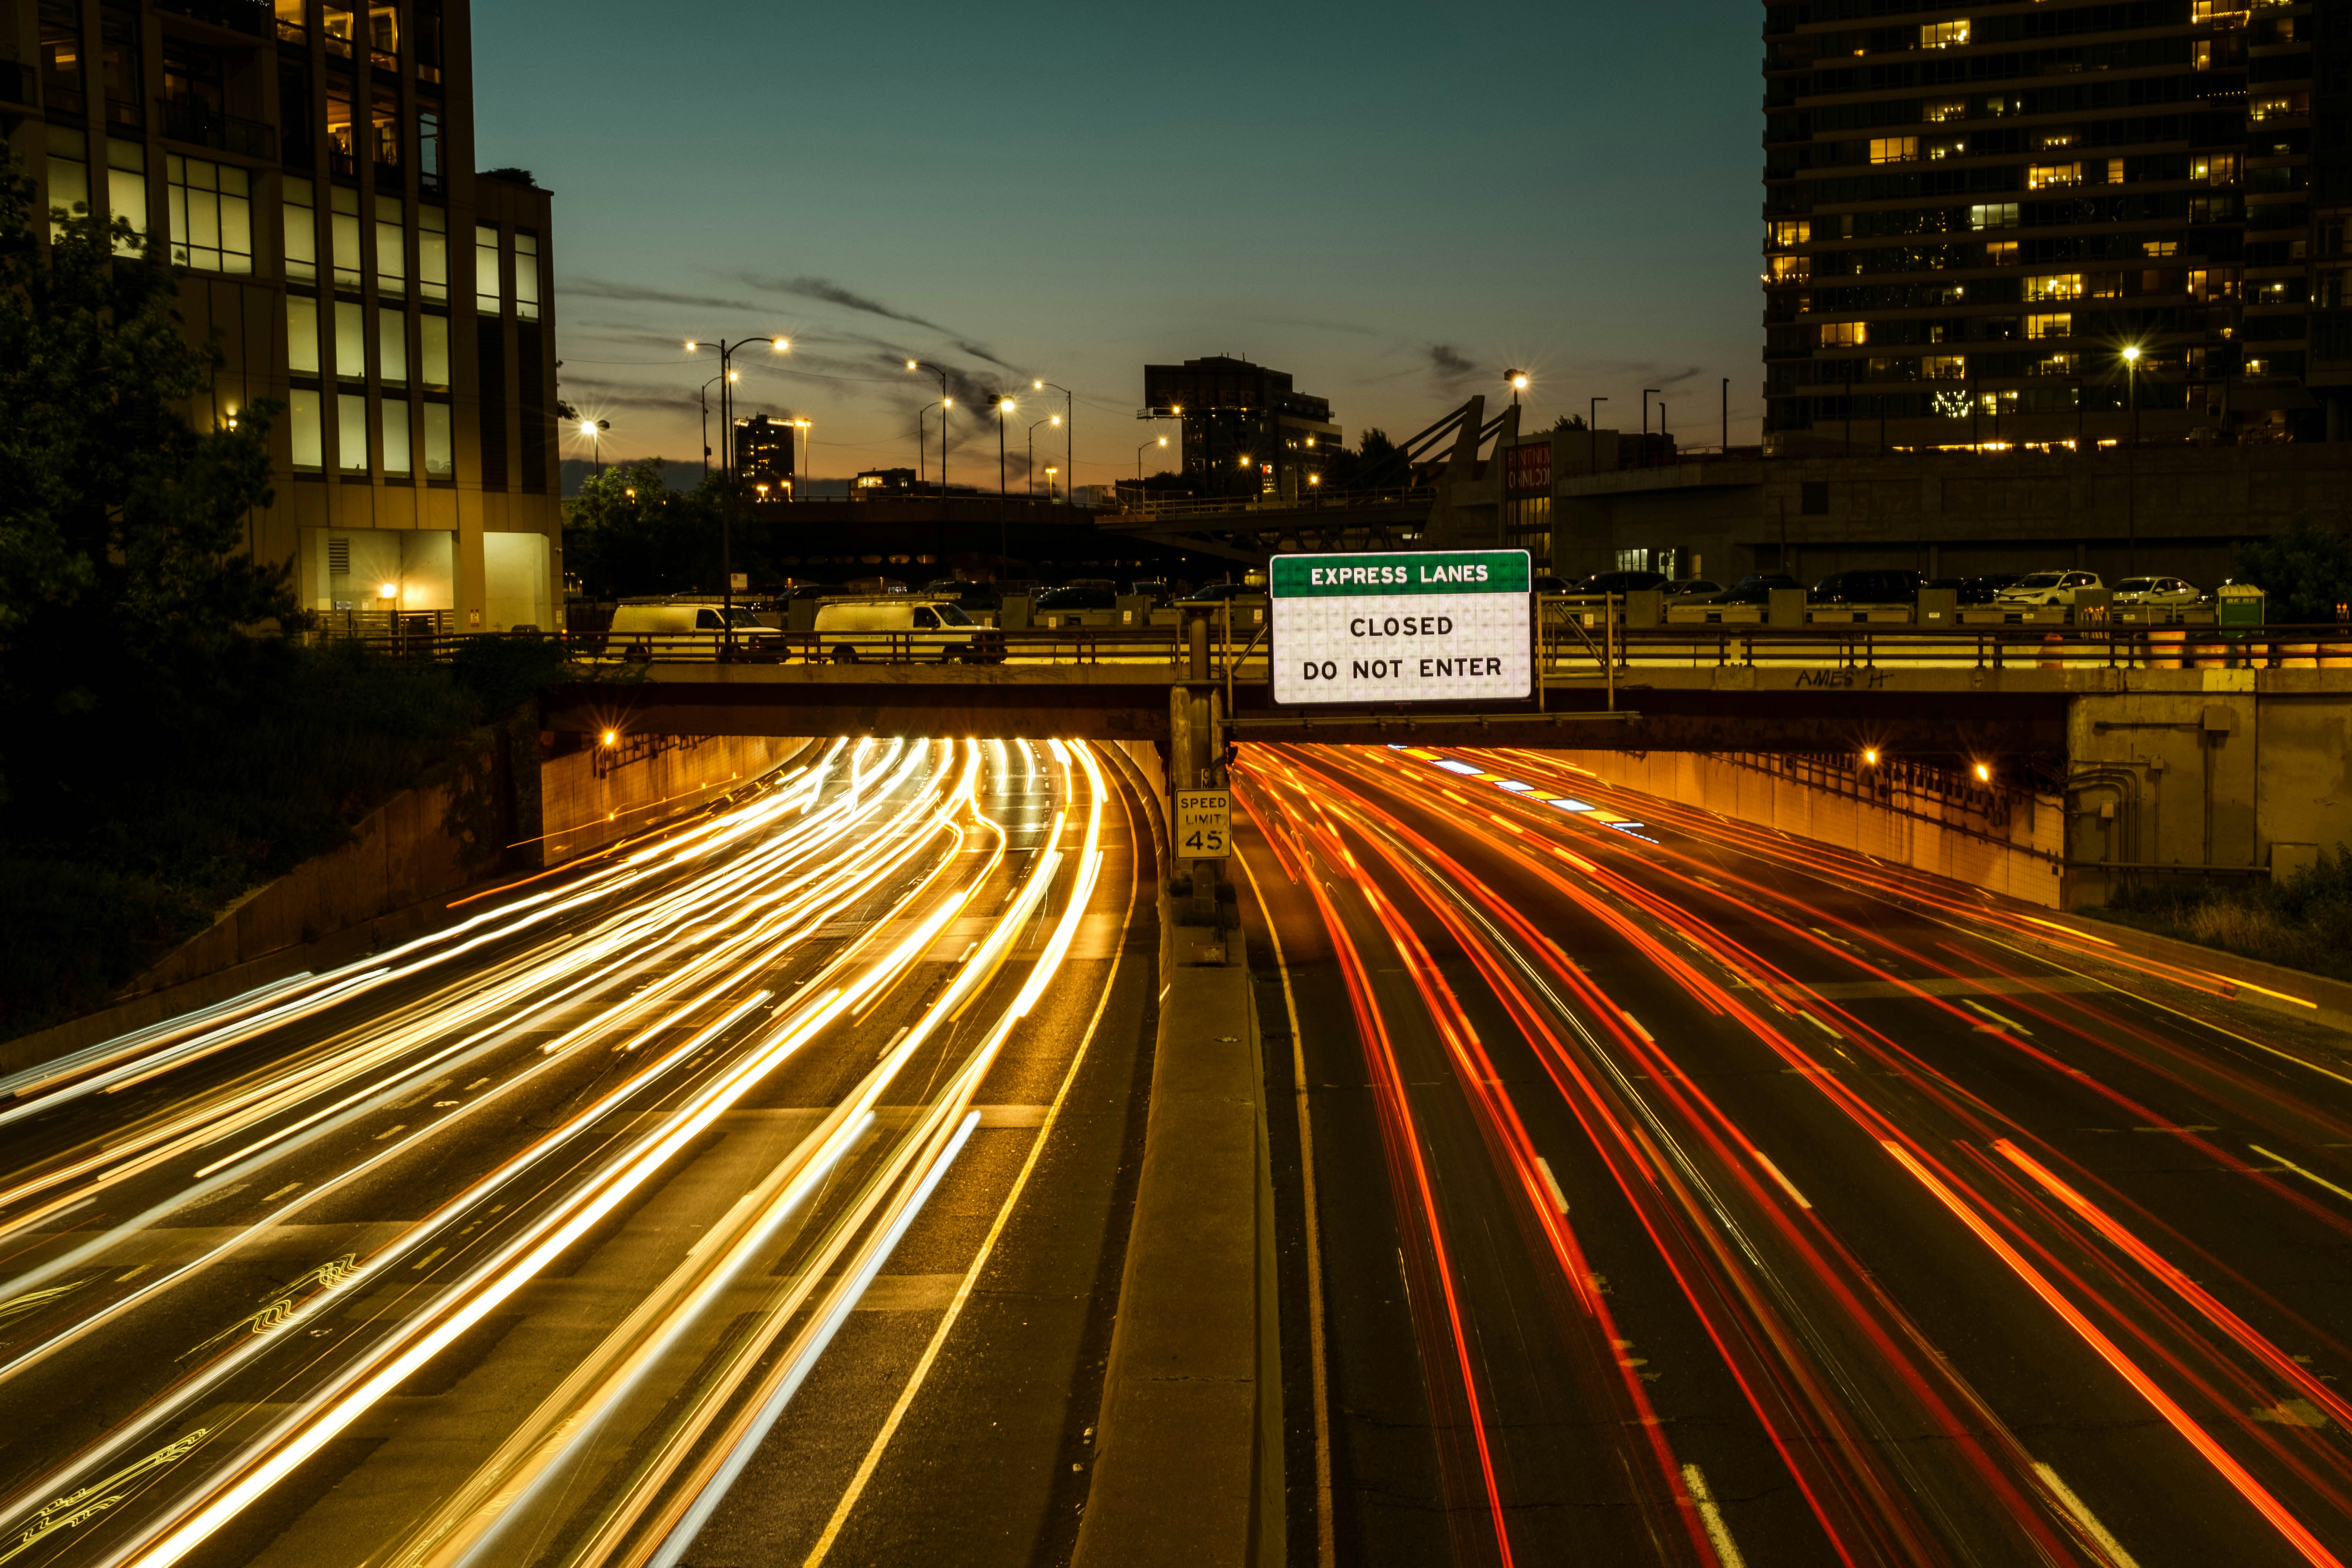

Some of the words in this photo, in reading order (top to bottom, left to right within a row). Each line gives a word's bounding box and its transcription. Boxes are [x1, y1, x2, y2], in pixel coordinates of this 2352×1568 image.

[1263, 465, 1272, 474] K2
[1311, 566, 1408, 585] EXPRESS
[1420, 565, 1488, 583] LANES
[1350, 617, 1453, 637] CLOSED
[1304, 661, 1337, 680] DO
[1353, 660, 1402, 679] NOT
[1420, 657, 1501, 677] ENTER
[1181, 798, 1226, 808] SPEED
[1186, 814, 1221, 825] LIMIT
[1185, 830, 1222, 850] 45
